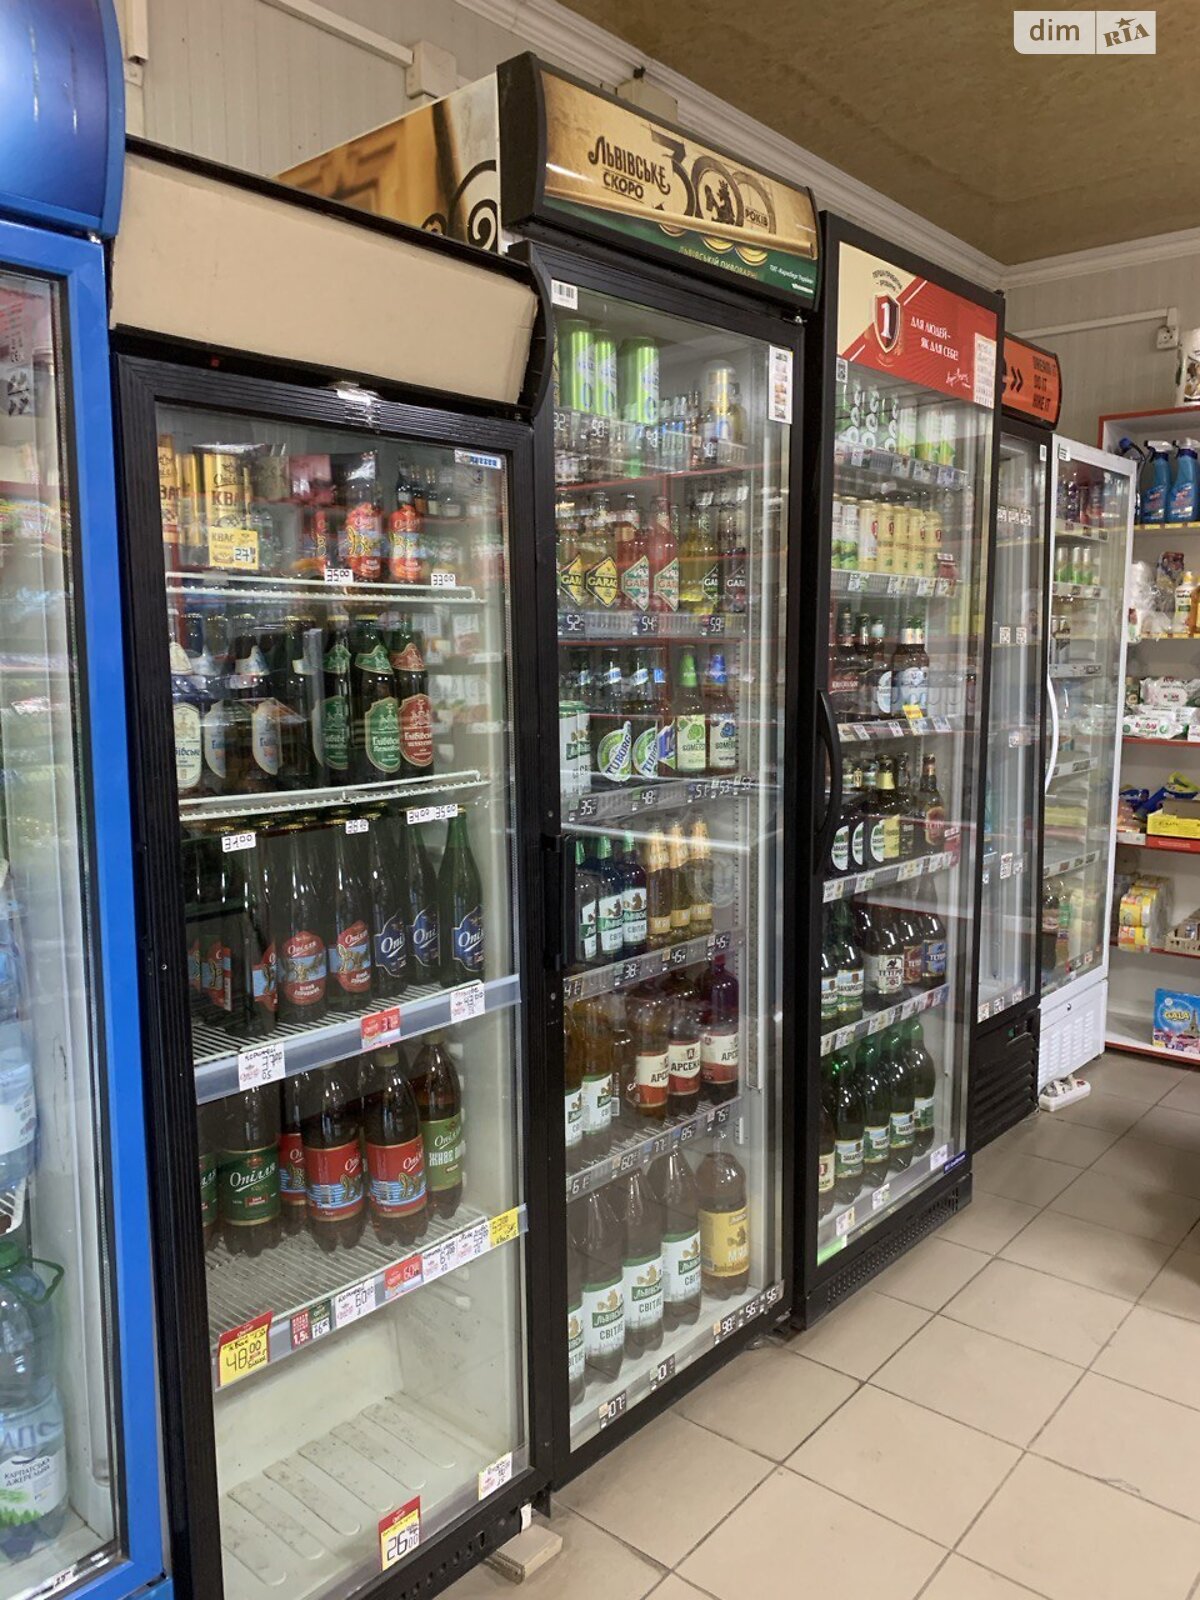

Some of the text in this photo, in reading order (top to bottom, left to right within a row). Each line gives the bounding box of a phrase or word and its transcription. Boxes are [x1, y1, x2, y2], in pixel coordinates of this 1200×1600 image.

[588, 136, 671, 195] ЛЬВІВСЬКЕ
[603, 173, 644, 199] СКОРО
[881, 302, 891, 339] 1
[604, 734, 632, 776] TUBORG
[229, 1162, 276, 1187] Опілля
